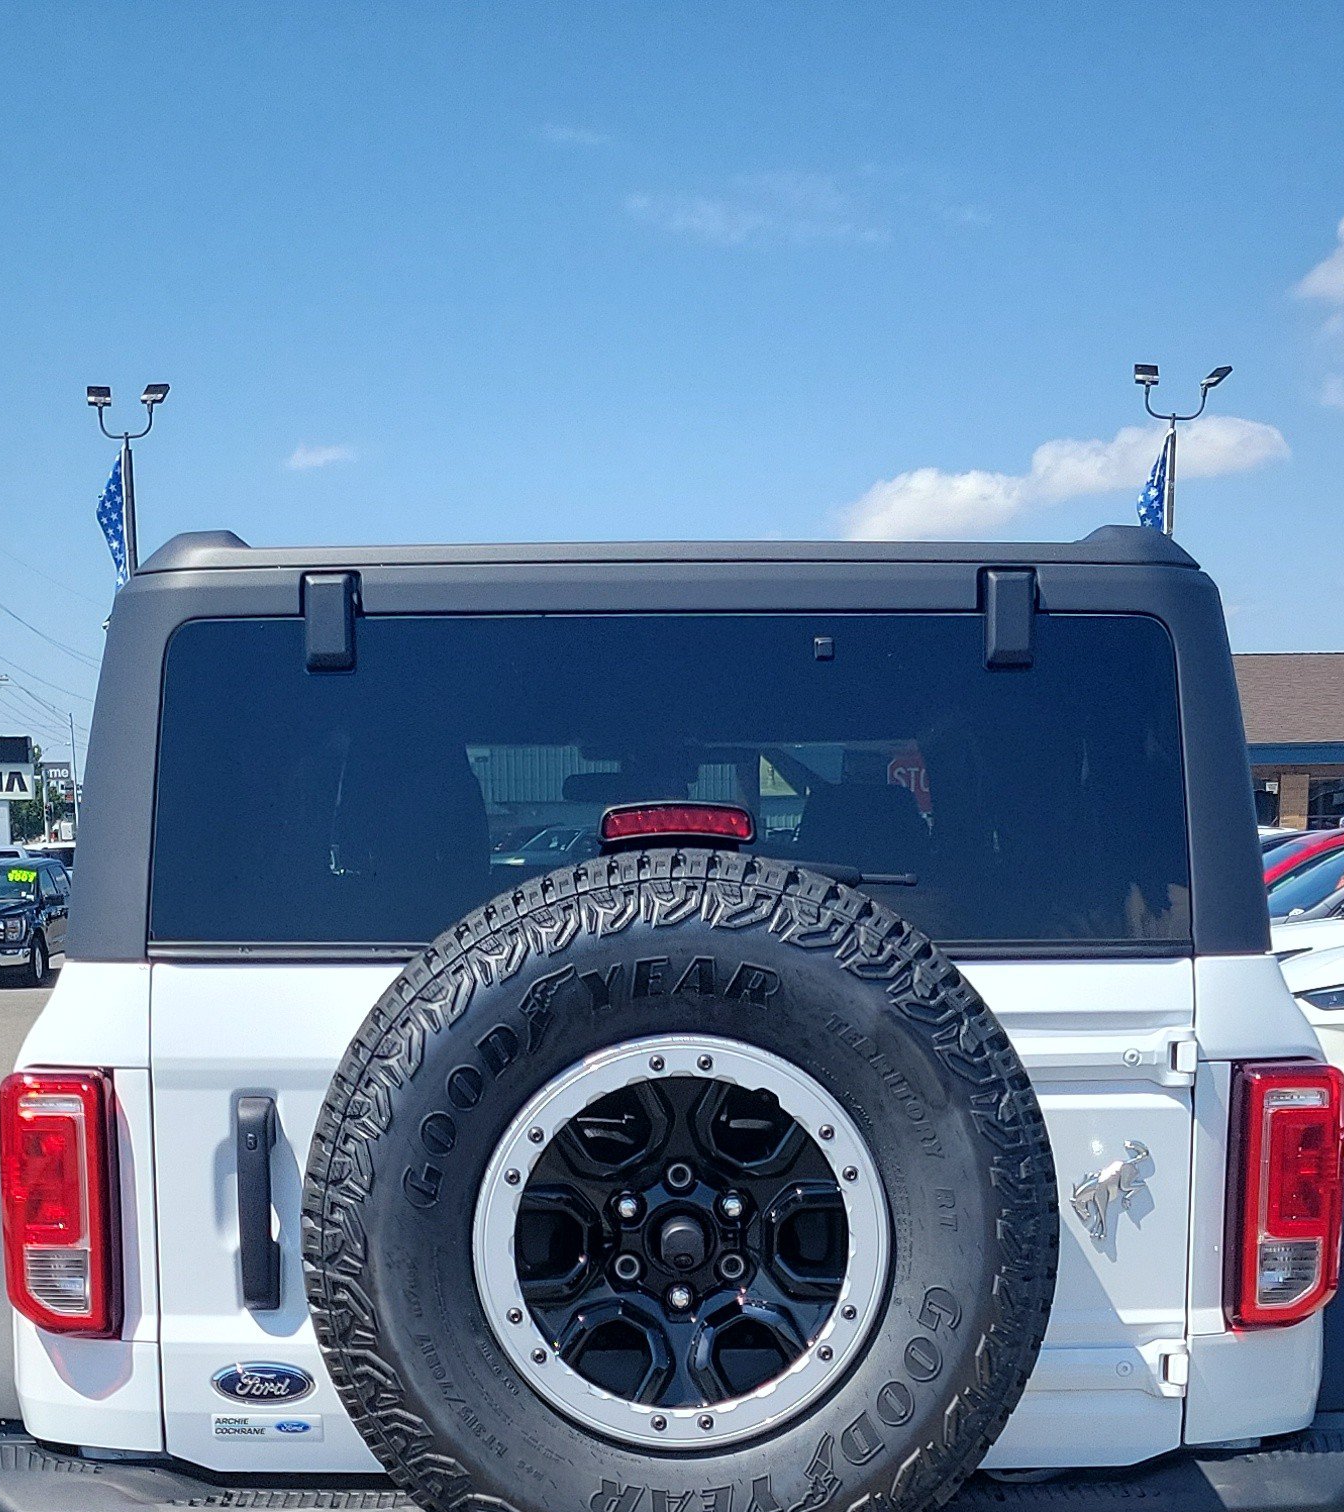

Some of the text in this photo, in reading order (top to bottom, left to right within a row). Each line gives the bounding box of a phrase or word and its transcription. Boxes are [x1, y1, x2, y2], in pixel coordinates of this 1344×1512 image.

[236, 1370, 290, 1396] Ford
[215, 1417, 249, 1425] ARCHIE
[215, 1427, 266, 1435] COCHRANE
